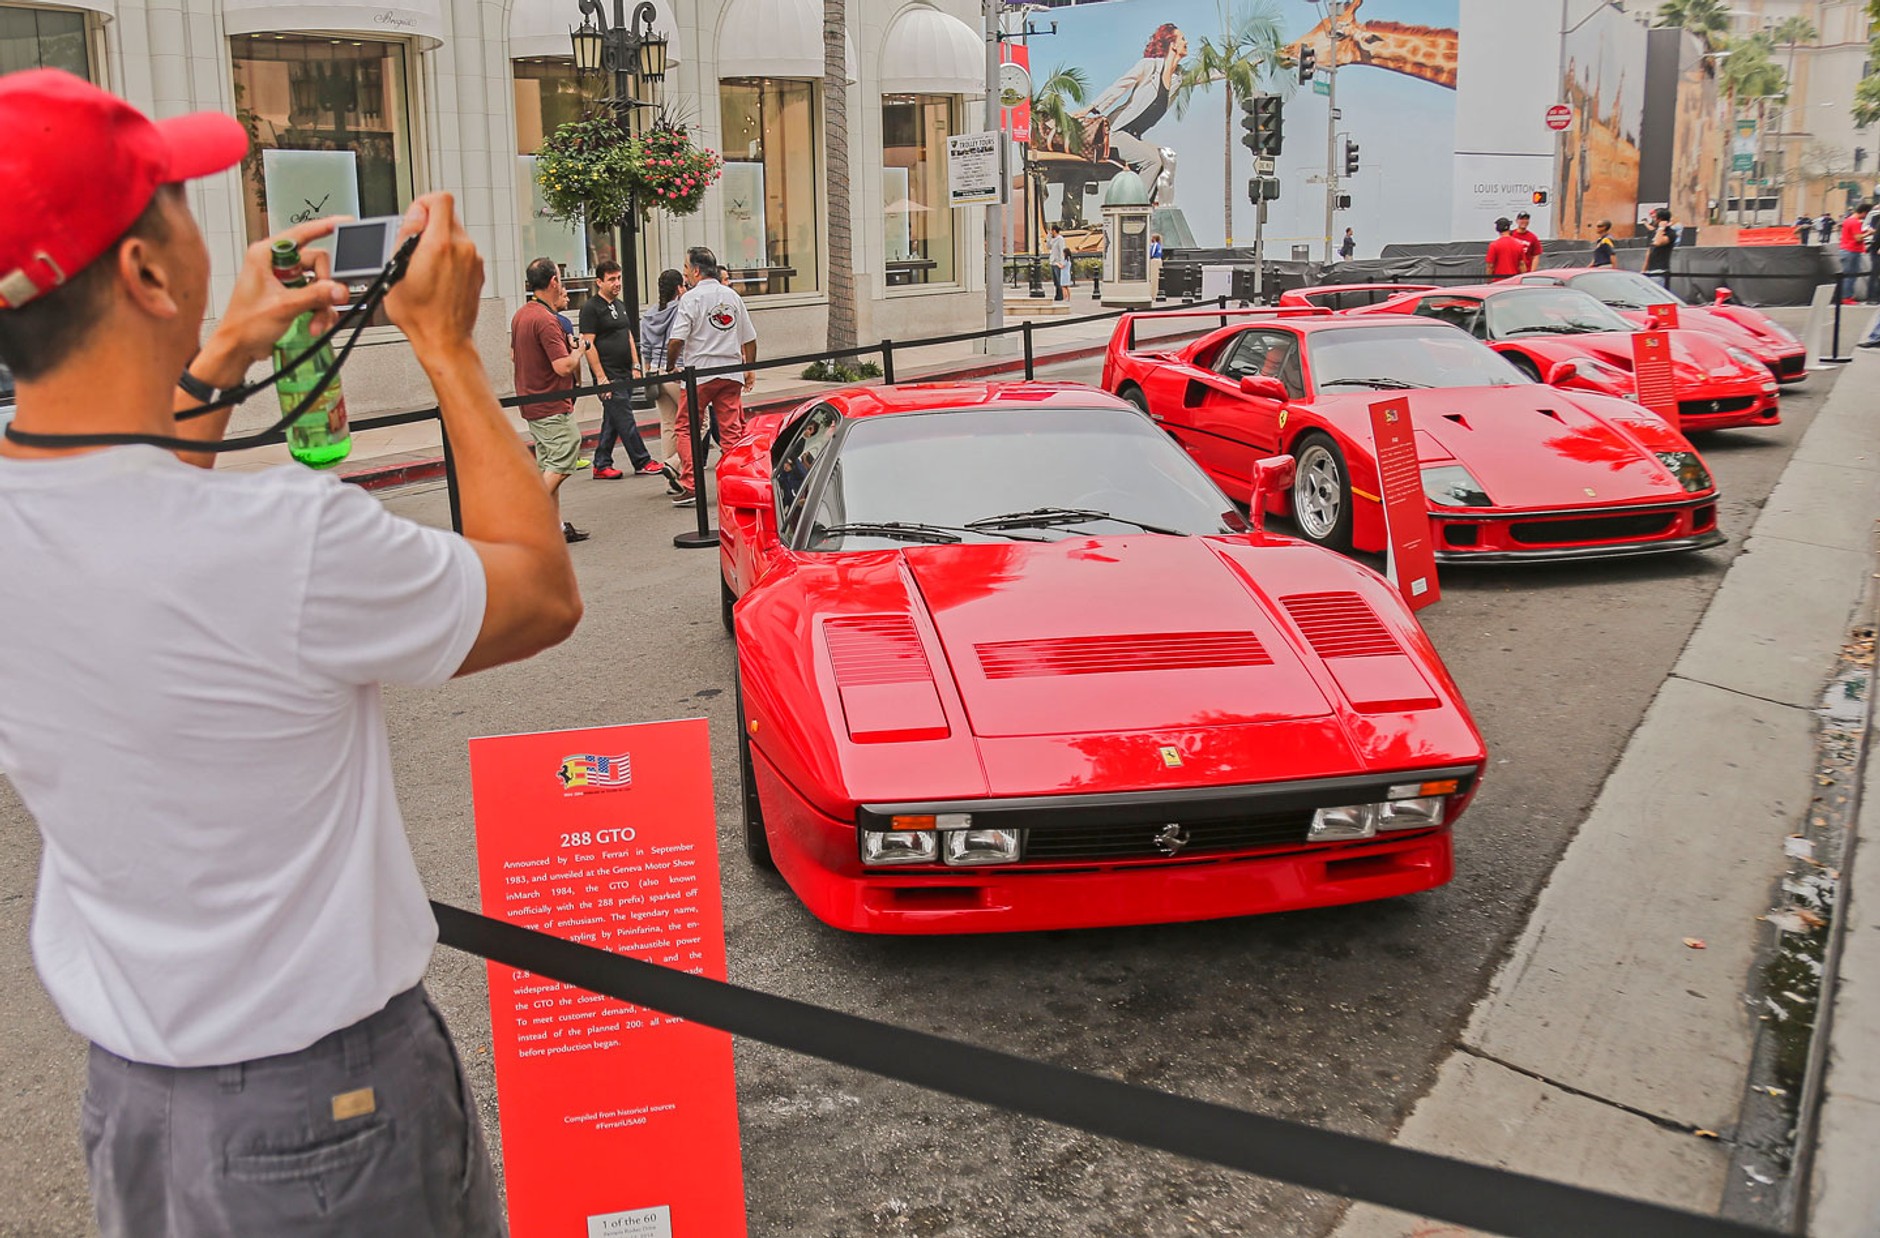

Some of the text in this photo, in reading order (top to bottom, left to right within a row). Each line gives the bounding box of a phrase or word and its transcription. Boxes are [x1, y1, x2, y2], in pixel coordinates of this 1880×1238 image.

[1474, 184, 1535, 193] LOUIS VUITTON
[561, 827, 636, 847] 288 GTO
[504, 857, 550, 868] Announced
[557, 856, 567, 865] by
[575, 854, 595, 862] Enzo
[602, 848, 629, 859] Ferrari
[651, 843, 694, 855] September
[506, 876, 529, 884] 1983,
[532, 873, 547, 882] and
[550, 870, 583, 880] unveiled
[597, 868, 610, 876] the
[613, 865, 642, 874] Geneva
[645, 862, 671, 871] Motor
[673, 859, 695, 868] Show
[552, 887, 575, 896] 1984,
[586, 884, 599, 892] the
[609, 881, 629, 890] GTO
[639, 878, 659, 888] (also
[669, 875, 696, 883] known
[508, 888, 698, 916] unofficially with the 288 prefix) sparked off
[544, 920, 553, 929] of
[558, 914, 606, 927] enthusiasm.
[611, 913, 626, 921] The
[631, 908, 669, 921] legendary
[570, 932, 596, 943] styling
[602, 930, 611, 939] by
[617, 925, 663, 936] Pininfarina,
[669, 922, 681, 930] the
[618, 940, 670, 952] inexhaustible
[676, 937, 701, 947] power
[664, 951, 702, 962] and the
[514, 982, 560, 994] widespread
[515, 1002, 528, 1010] the
[533, 999, 554, 1008] GTO
[559, 998, 572, 1006] the
[577, 994, 605, 1004] closest
[516, 1018, 527, 1026] To
[533, 1016, 553, 1024] meet
[559, 1011, 596, 1022] customer
[602, 1004, 636, 1016] demand,
[518, 1031, 547, 1042] instead
[554, 1029, 562, 1038] of
[568, 1028, 581, 1036] the
[587, 1023, 619, 1036] planned
[650, 1017, 659, 1026] all
[519, 1040, 621, 1057] before production began.
[564, 1103, 676, 1123] Compiled from historical sources
[611, 1217, 623, 1228] of
[625, 1216, 641, 1225] the
[644, 1213, 657, 1223] 60
